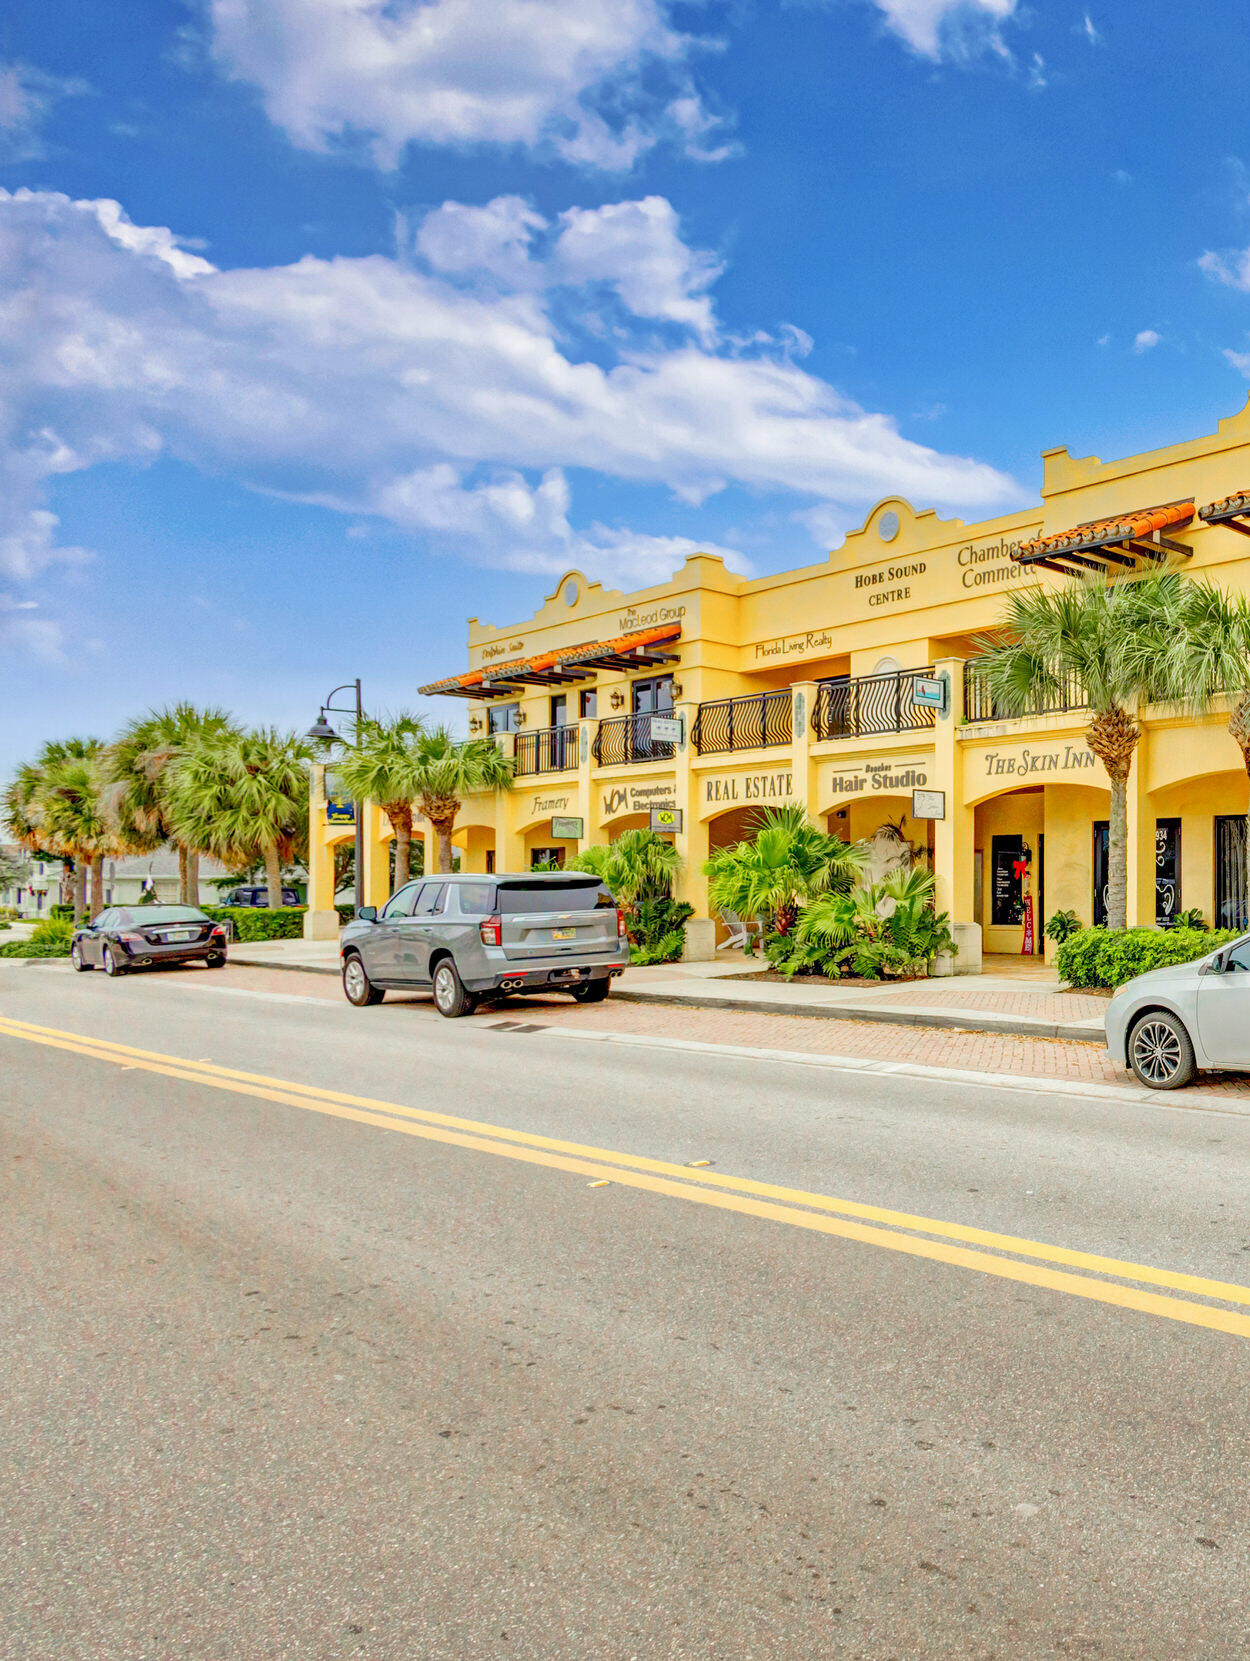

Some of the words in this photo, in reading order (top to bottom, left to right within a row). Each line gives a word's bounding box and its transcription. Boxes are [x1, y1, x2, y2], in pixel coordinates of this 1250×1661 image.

[957, 538, 1023, 567] Chamber
[962, 563, 1037, 588] Commerce
[869, 587, 911, 606] CENTRE
[659, 605, 686, 622] Group
[755, 644, 781, 659] Florida
[781, 640, 806, 655] Living
[806, 632, 832, 649] Realty
[630, 785, 671, 797] Computers
[706, 779, 738, 801] REAL
[745, 774, 793, 798] ESTATE
[832, 775, 867, 793] Hair
[871, 771, 927, 789] Studio
[531, 796, 569, 815] Framery
[1155, 830, 1168, 840] 934
